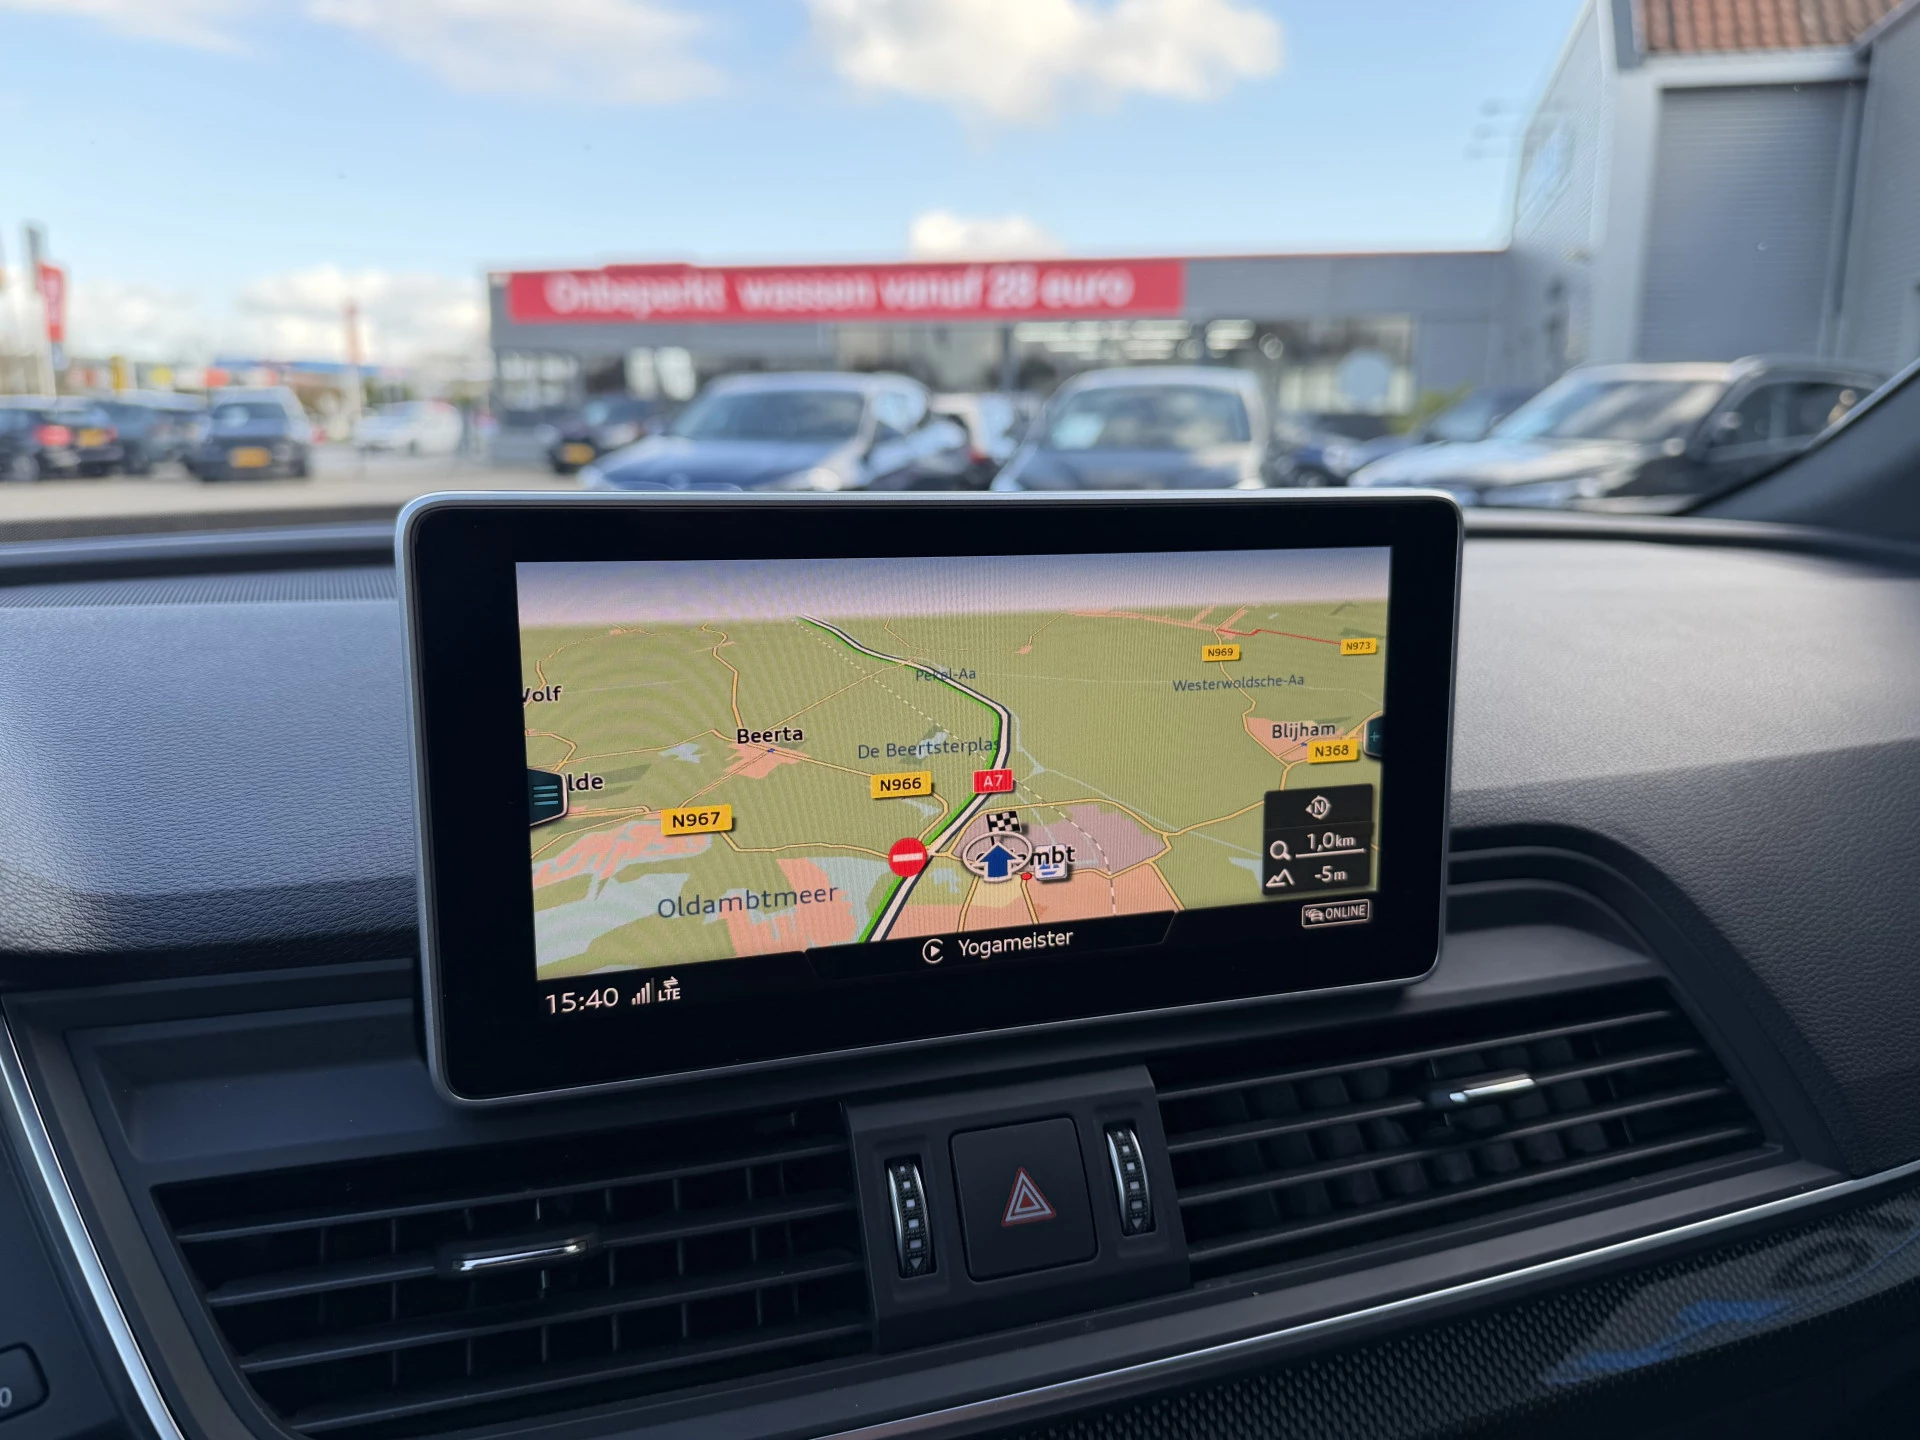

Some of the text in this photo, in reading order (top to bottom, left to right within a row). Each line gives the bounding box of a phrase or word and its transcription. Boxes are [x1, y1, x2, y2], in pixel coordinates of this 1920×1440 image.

[1207, 648, 1234, 657] N969
[1345, 641, 1371, 651] N973
[1172, 675, 1305, 692] Westerwoldsche-Aa
[736, 726, 804, 744] Beerta
[1271, 722, 1336, 742] Blijham
[858, 744, 880, 759] De
[1314, 745, 1349, 758] N368
[880, 777, 922, 792] N966
[983, 774, 1003, 788] A7
[672, 812, 721, 829] N967
[657, 886, 839, 918] Oldambtmeer
[1325, 904, 1366, 919] ONLINE
[957, 930, 1074, 960] Yogameister
[545, 987, 619, 1015] 15:40
[658, 987, 682, 1002] LTE
